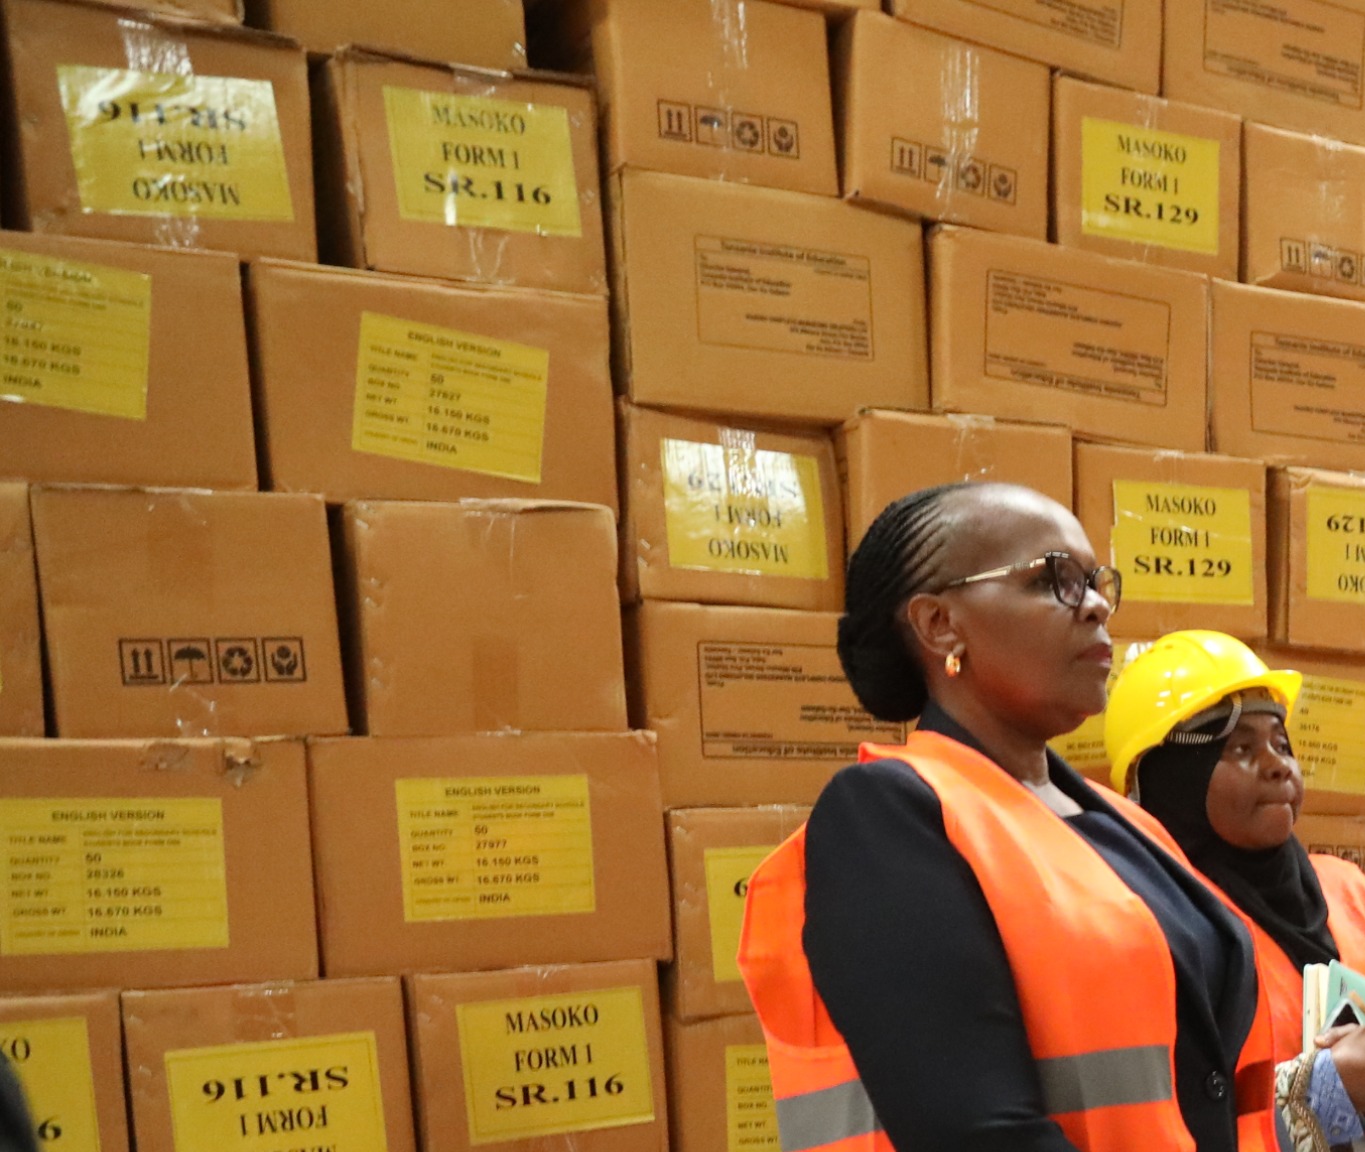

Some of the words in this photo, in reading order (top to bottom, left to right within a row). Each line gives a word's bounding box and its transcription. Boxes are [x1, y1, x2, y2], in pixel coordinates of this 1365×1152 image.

[432, 104, 526, 136] MASOKO
[156, 140, 229, 166] FORM
[441, 141, 506, 169] FORM
[513, 151, 520, 170] 1
[1117, 133, 1187, 164] MASOKO
[132, 176, 240, 206] MASOKO
[423, 171, 552, 205] SR.116
[1121, 167, 1168, 193] FORM
[1174, 177, 1179, 196] 1
[1103, 193, 1199, 226] SR.129
[1146, 493, 1217, 518] MASOKO
[1150, 526, 1199, 548] FORM
[1203, 527, 1211, 549] 1
[708, 538, 789, 564] MASOKO
[1345, 544, 1351, 561] 1
[1133, 555, 1232, 578] SR.129
[444, 786, 492, 798] ENGLISH
[494, 784, 541, 796] VERSION
[111, 809, 165, 821] VERSION
[514, 854, 539, 866] KGS
[515, 872, 540, 884] KGS
[132, 886, 162, 897] KGS
[478, 893, 511, 905] INDIA
[133, 905, 163, 916] KGS
[90, 926, 128, 938] INDIA
[505, 1003, 599, 1036] MASOKO
[514, 1043, 577, 1073] FORM
[586, 1042, 592, 1064] 1
[202, 1065, 349, 1104] SR.116
[494, 1072, 625, 1111] SR.116
[239, 1114, 248, 1137] 1
[257, 1103, 328, 1136] FORM
